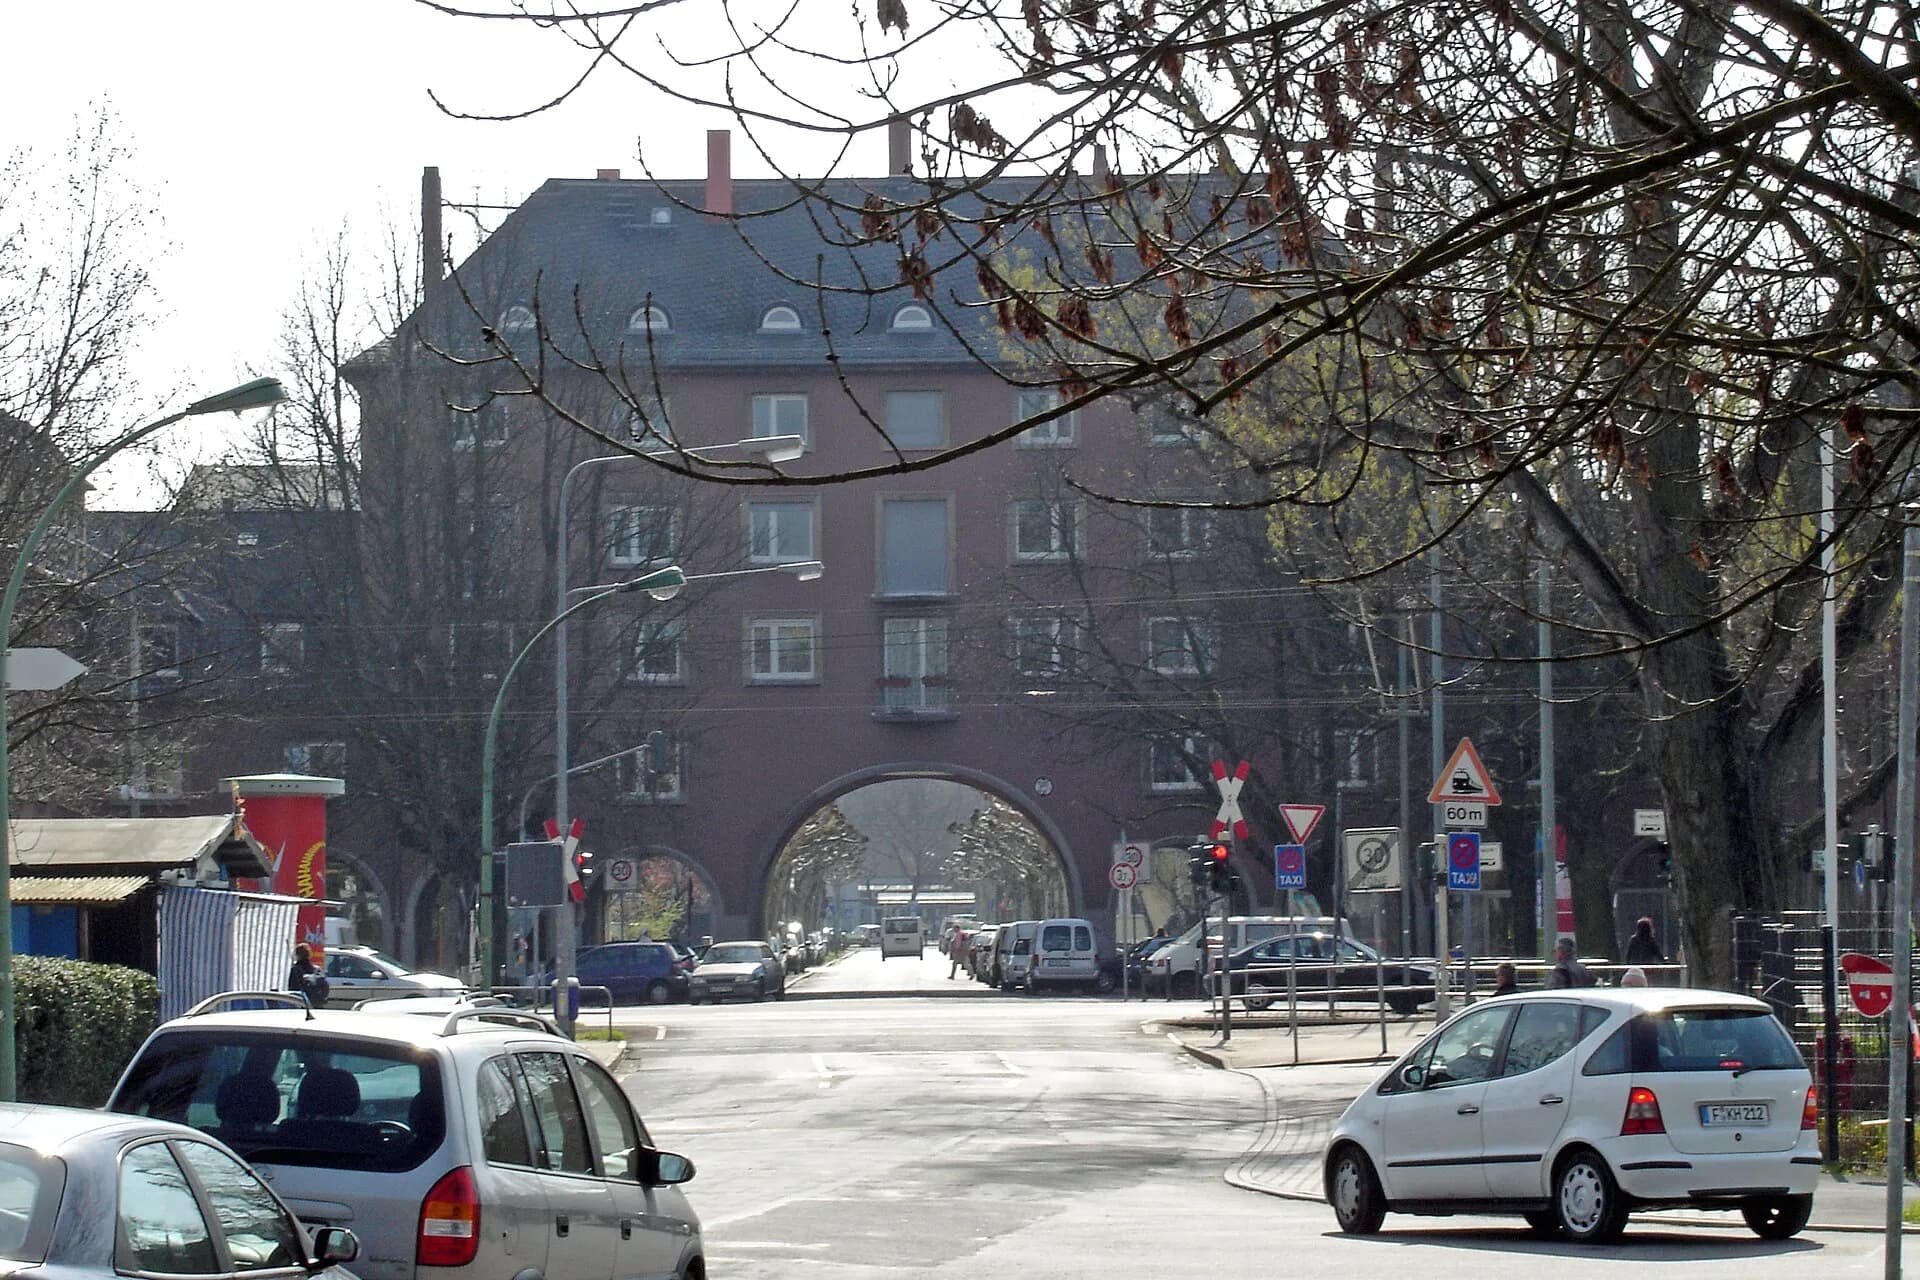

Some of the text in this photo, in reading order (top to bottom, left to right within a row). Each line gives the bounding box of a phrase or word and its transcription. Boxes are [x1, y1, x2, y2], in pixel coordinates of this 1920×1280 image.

[1447, 807, 1482, 820] 60 m
[1363, 847, 1384, 864] 30
[1280, 875, 1303, 886] TAXI
[1712, 1108, 1719, 1121] F
[1743, 1107, 1764, 1120] 212
